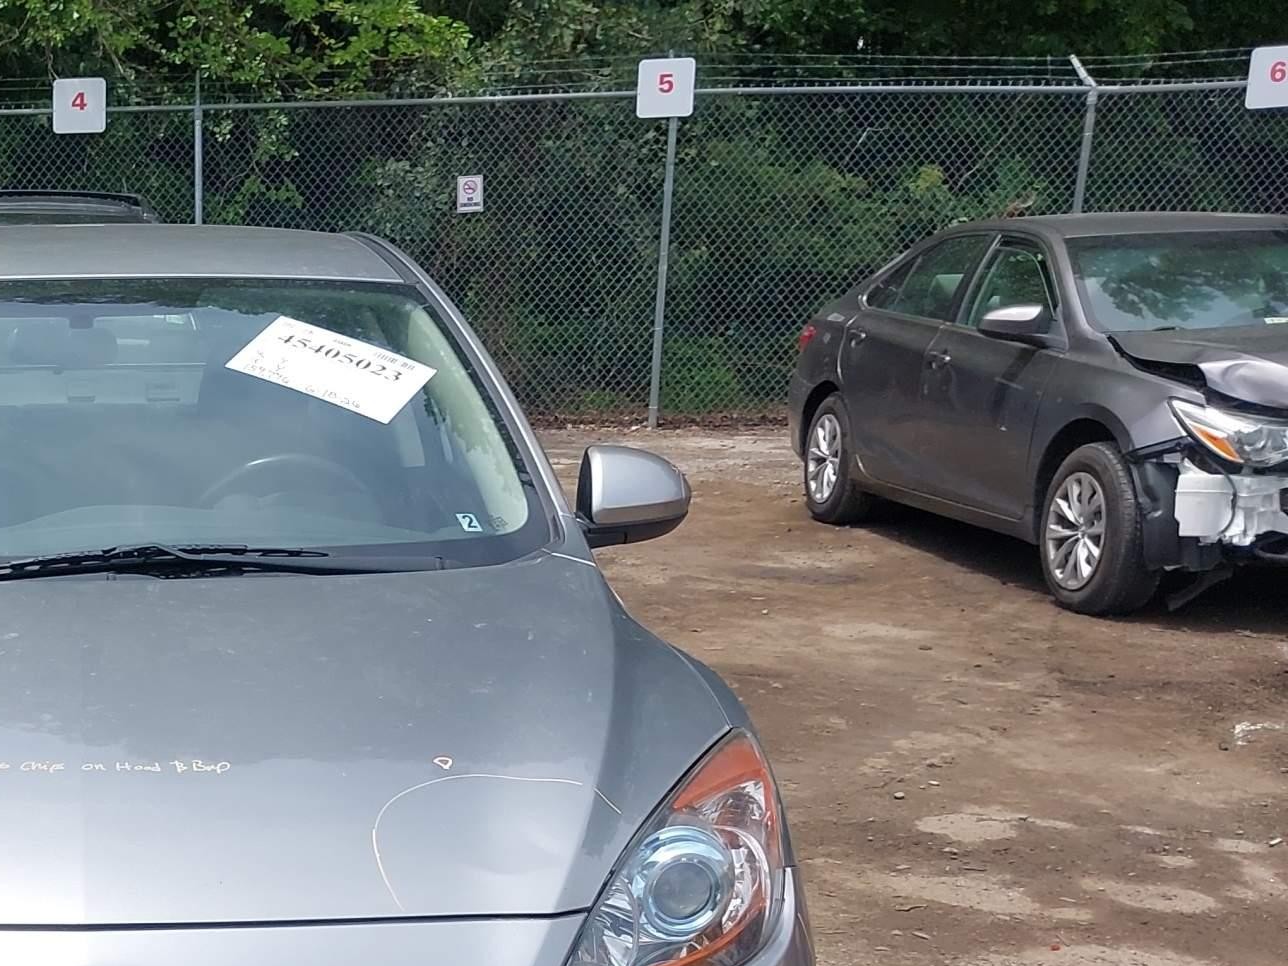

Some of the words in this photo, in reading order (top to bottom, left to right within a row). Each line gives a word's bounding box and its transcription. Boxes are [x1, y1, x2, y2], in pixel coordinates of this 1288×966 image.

[1270, 61, 1287, 82] 6
[658, 74, 674, 93] 5
[71, 92, 87, 110] 4
[278, 335, 403, 381] 45405023
[462, 514, 478, 528] 2
[80, 763, 107, 771] on
[115, 761, 161, 772] Hood
